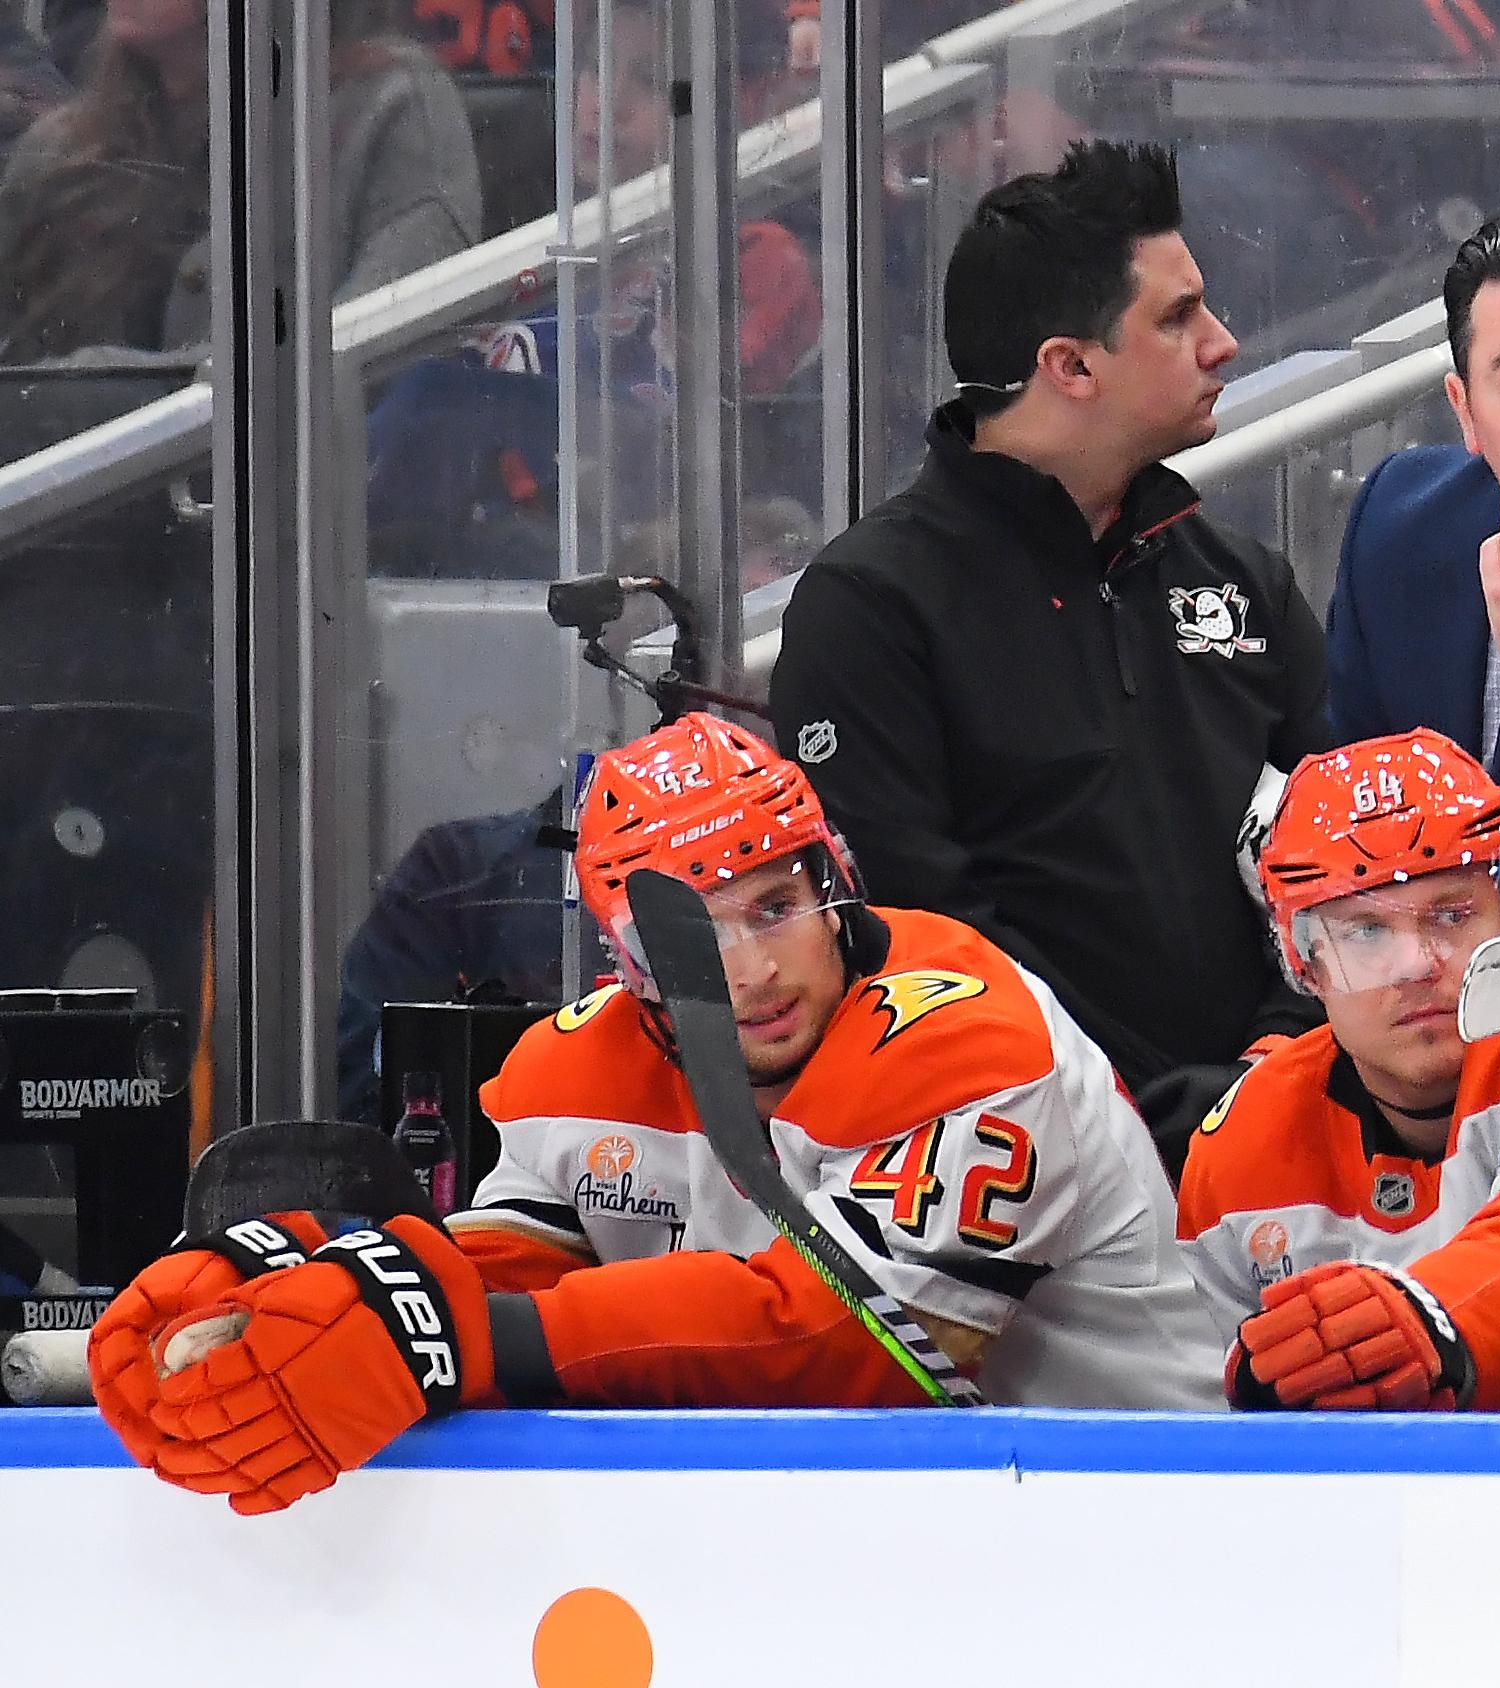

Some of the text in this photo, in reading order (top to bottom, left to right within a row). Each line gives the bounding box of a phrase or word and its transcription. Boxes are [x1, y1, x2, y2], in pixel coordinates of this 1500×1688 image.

[654, 762, 711, 795] 42
[1353, 768, 1405, 813] 64
[669, 808, 744, 849] BAUER
[20, 1078, 161, 1109] BODYARMOR
[574, 1171, 679, 1219] Anaheim
[850, 1112, 1038, 1250] 42
